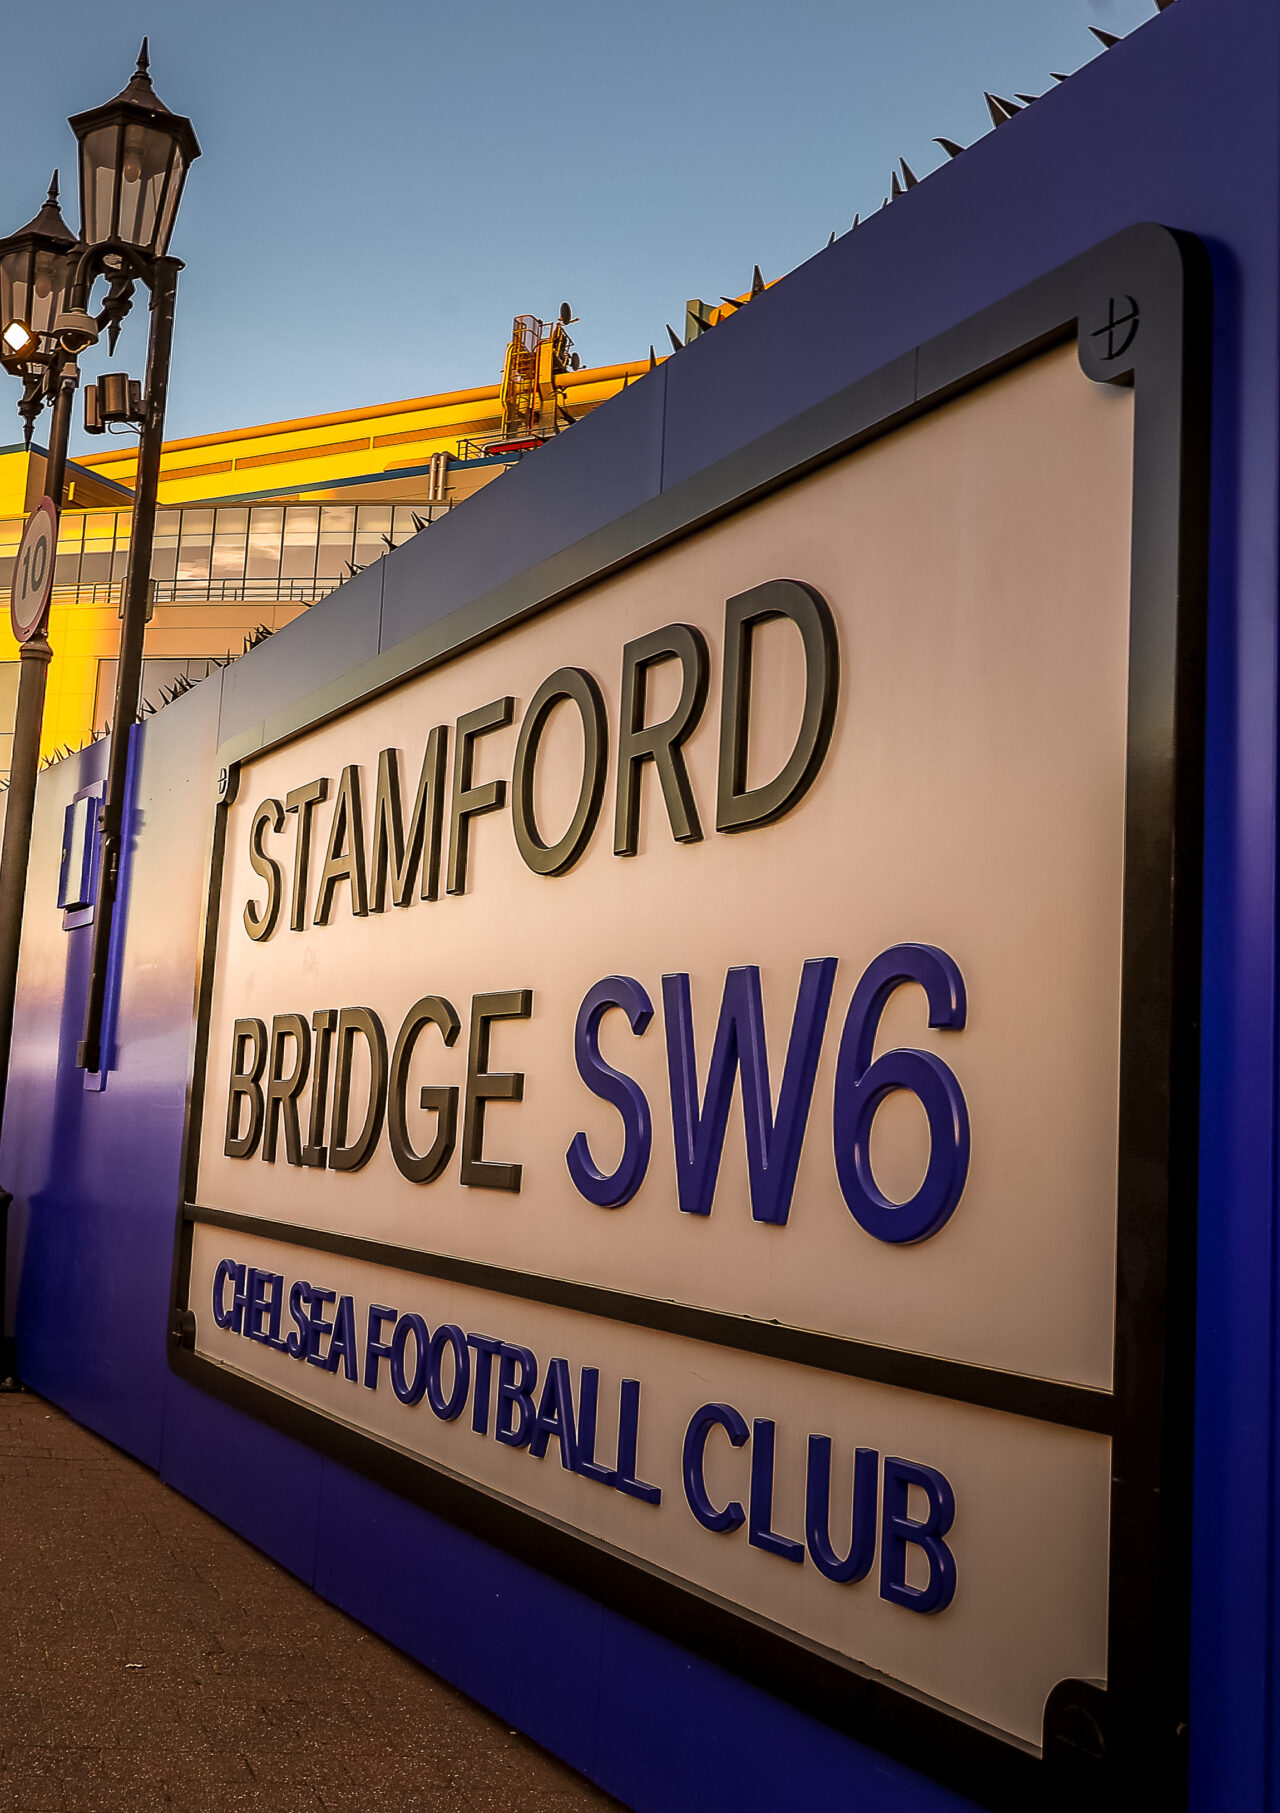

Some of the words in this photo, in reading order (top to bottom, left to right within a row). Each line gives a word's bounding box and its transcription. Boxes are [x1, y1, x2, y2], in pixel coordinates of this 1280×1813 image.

[22, 534, 47, 600] 10
[243, 578, 840, 942] STAMFORD
[224, 989, 533, 1193] BRIDGE
[565, 943, 970, 1244] SW6
[213, 1258, 358, 1383] CHELSEA
[363, 1303, 662, 1506] FOOTBALL
[681, 1402, 957, 1614] CLUB
